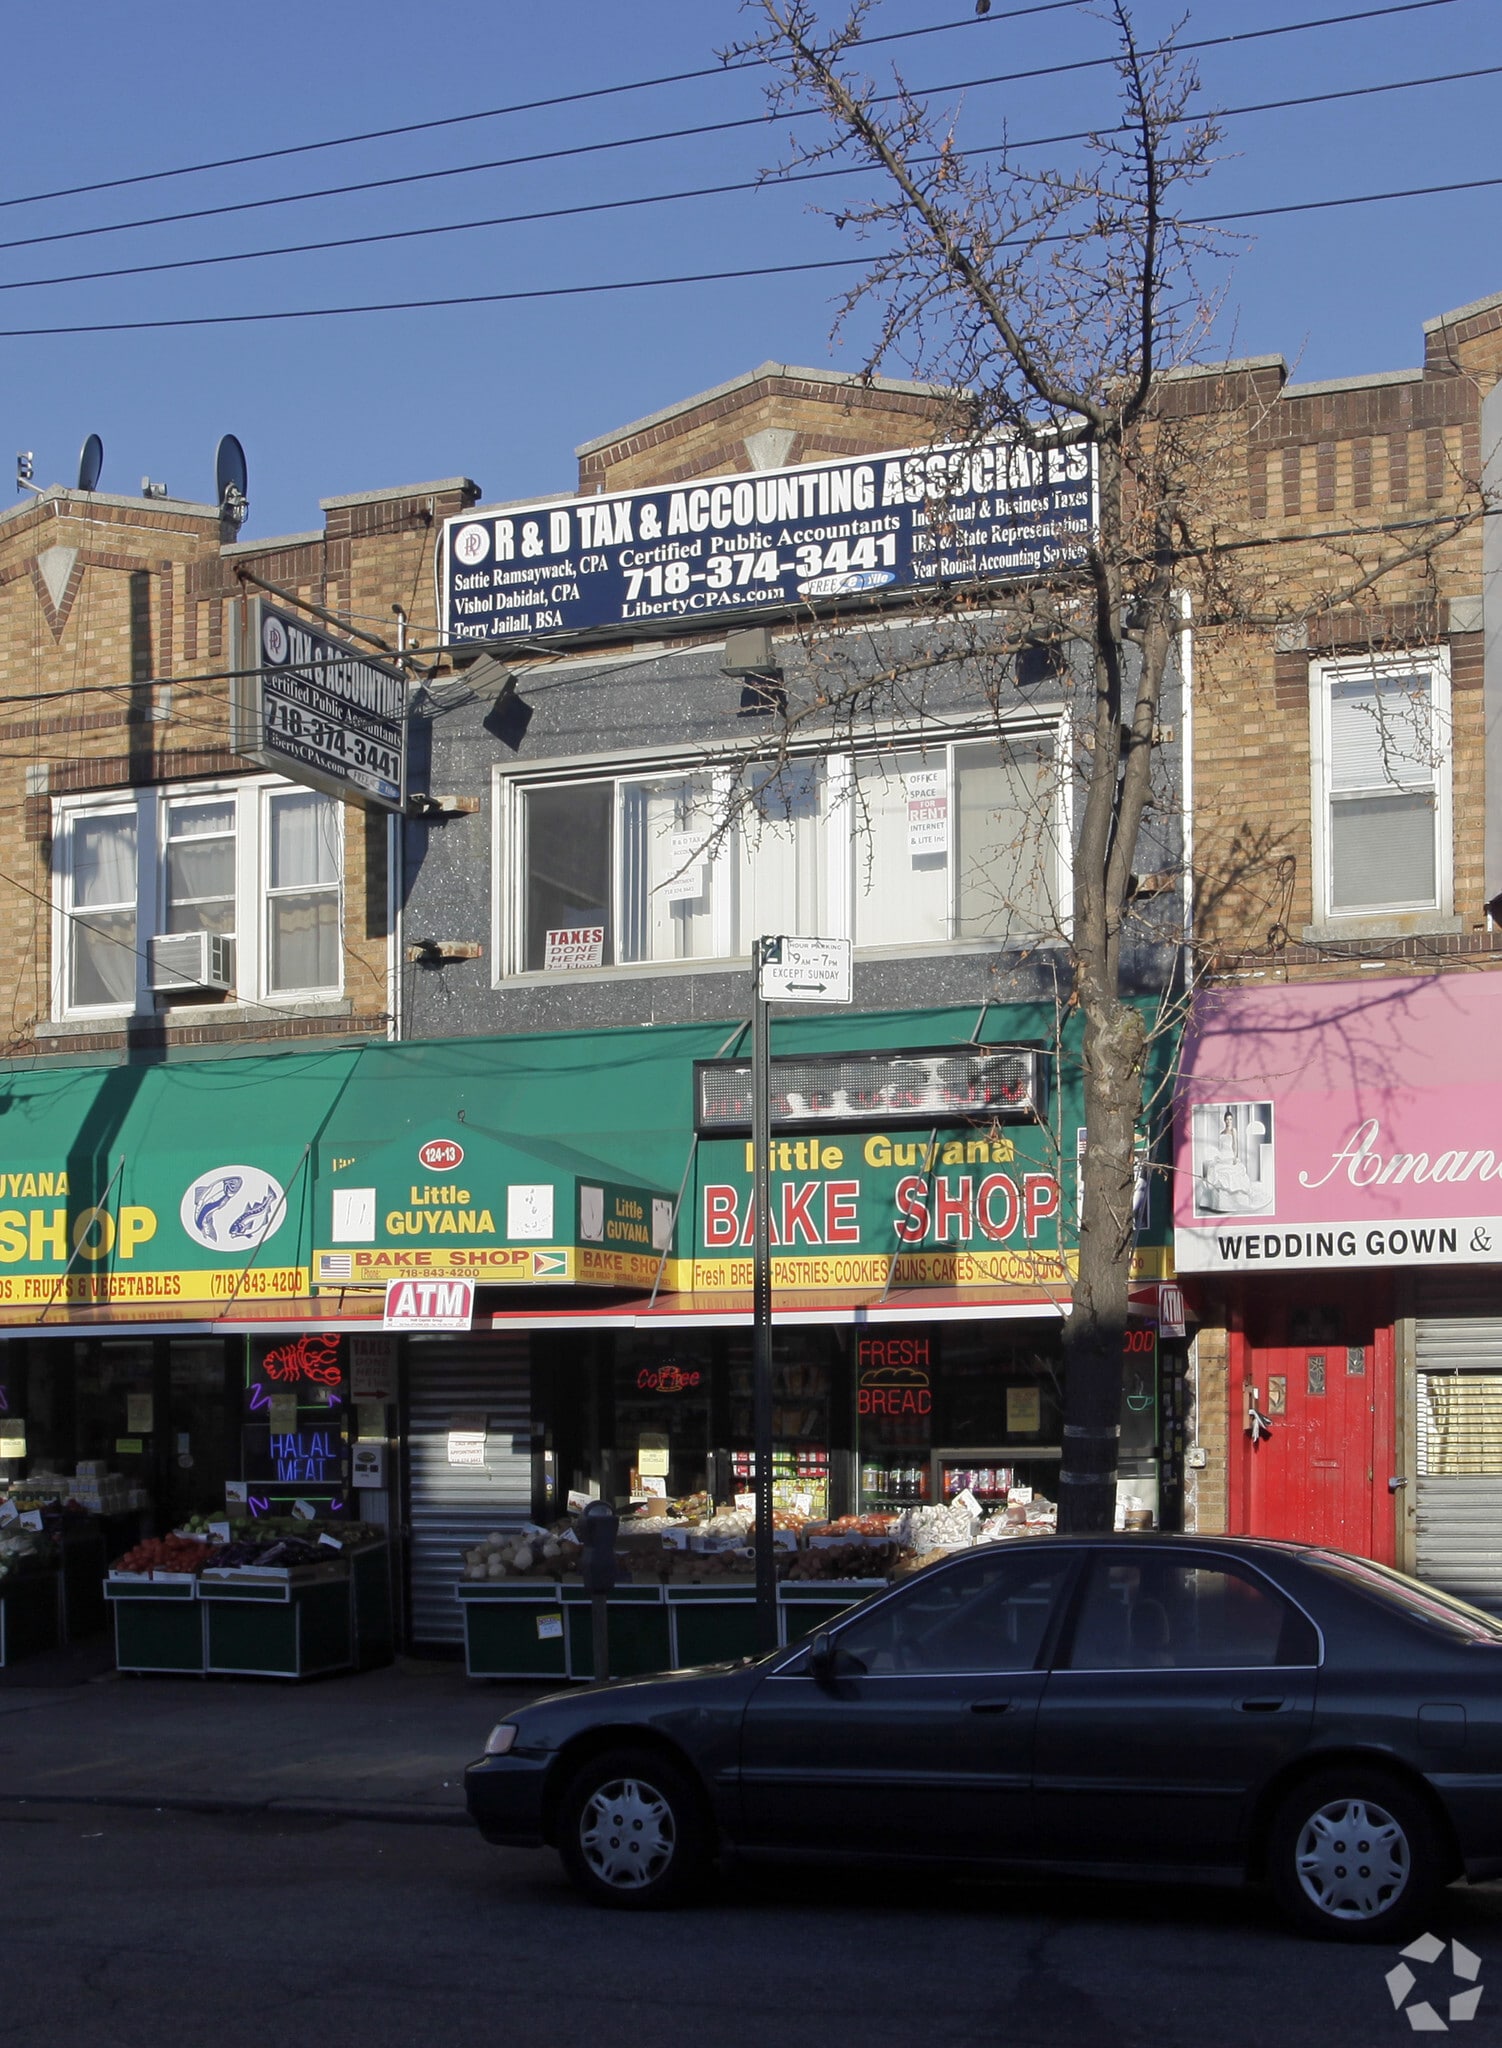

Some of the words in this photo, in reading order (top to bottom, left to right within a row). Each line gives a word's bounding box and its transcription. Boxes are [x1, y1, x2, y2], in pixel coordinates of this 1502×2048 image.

[495, 520, 514, 562] R
[522, 521, 543, 558] &
[550, 511, 570, 554] D
[577, 500, 634, 549] TAX
[639, 503, 662, 540] &
[667, 464, 875, 536] ACCOUNTING
[882, 442, 1088, 507] ASSOCIATES
[980, 499, 991, 518] &
[1053, 490, 1088, 509] Taxes
[619, 538, 701, 568] Certified
[711, 531, 773, 558] Public
[777, 513, 901, 547] Accountants
[622, 532, 895, 601] 718-374-3441
[979, 547, 1040, 572] Accounting
[454, 571, 490, 592] Sattie
[493, 558, 577, 588] Ramsaywack,
[580, 554, 609, 574] CPA
[810, 578, 837, 593] FREE
[454, 594, 493, 615] Vishol
[496, 588, 548, 610] Dabidat,
[551, 584, 580, 603] CPA
[621, 587, 785, 618] LibertyCPAs.com
[454, 622, 488, 641] Terry
[491, 612, 532, 635] Jailall,
[535, 609, 563, 629] BSA
[288, 625, 313, 681] TAX
[314, 646, 325, 687] &
[325, 645, 403, 726] ACCOUNTING
[312, 690, 343, 718] Public
[266, 694, 400, 782] 718-374-3441
[909, 772, 938, 784] OFFICE
[910, 788, 936, 799] SPACE
[920, 800, 936, 809] FOR
[910, 807, 946, 822] RENT
[910, 822, 945, 832] INTERNET
[549, 929, 602, 945] TAXES
[551, 944, 599, 955] DONE
[551, 953, 597, 963] HERE
[763, 938, 779, 963] 2
[773, 968, 803, 979] EXCEPT
[808, 969, 840, 980] SUNDAY
[424, 1146, 456, 1163] 124-13
[864, 1135, 1015, 1173] Guyana
[1298, 1118, 1502, 1189] Aman
[411, 1184, 471, 1205] Little
[616, 1198, 643, 1220] Little
[703, 1179, 861, 1248] BAKE
[893, 1172, 1059, 1244] SHOP
[0, 1206, 158, 1263] SHOP
[386, 1210, 496, 1235] GUYANA
[607, 1220, 650, 1244] GUYANA
[1219, 1231, 1357, 1260] WEDDING
[1366, 1228, 1457, 1257] GOWN
[1470, 1226, 1492, 1252] &
[355, 1251, 432, 1267] BAKE
[449, 1250, 530, 1266] SHOP
[583, 1251, 623, 1271] BAKE
[631, 1256, 667, 1275] SHOP
[399, 1267, 480, 1279] 718-843-4200
[695, 1264, 725, 1287] Fresh
[775, 1261, 829, 1285] PASTRIES
[895, 1258, 926, 1281] BUNS
[933, 1257, 974, 1281] CAKES
[24, 1278, 73, 1298] FRUITS
[78, 1278, 86, 1297] &
[91, 1274, 181, 1297] VEGETABLES
[393, 1282, 465, 1317] ATM
[1163, 1290, 1183, 1323] ATM
[859, 1338, 930, 1366] FRESH
[858, 1389, 932, 1415] BREAD
[269, 1432, 336, 1459] HALAL
